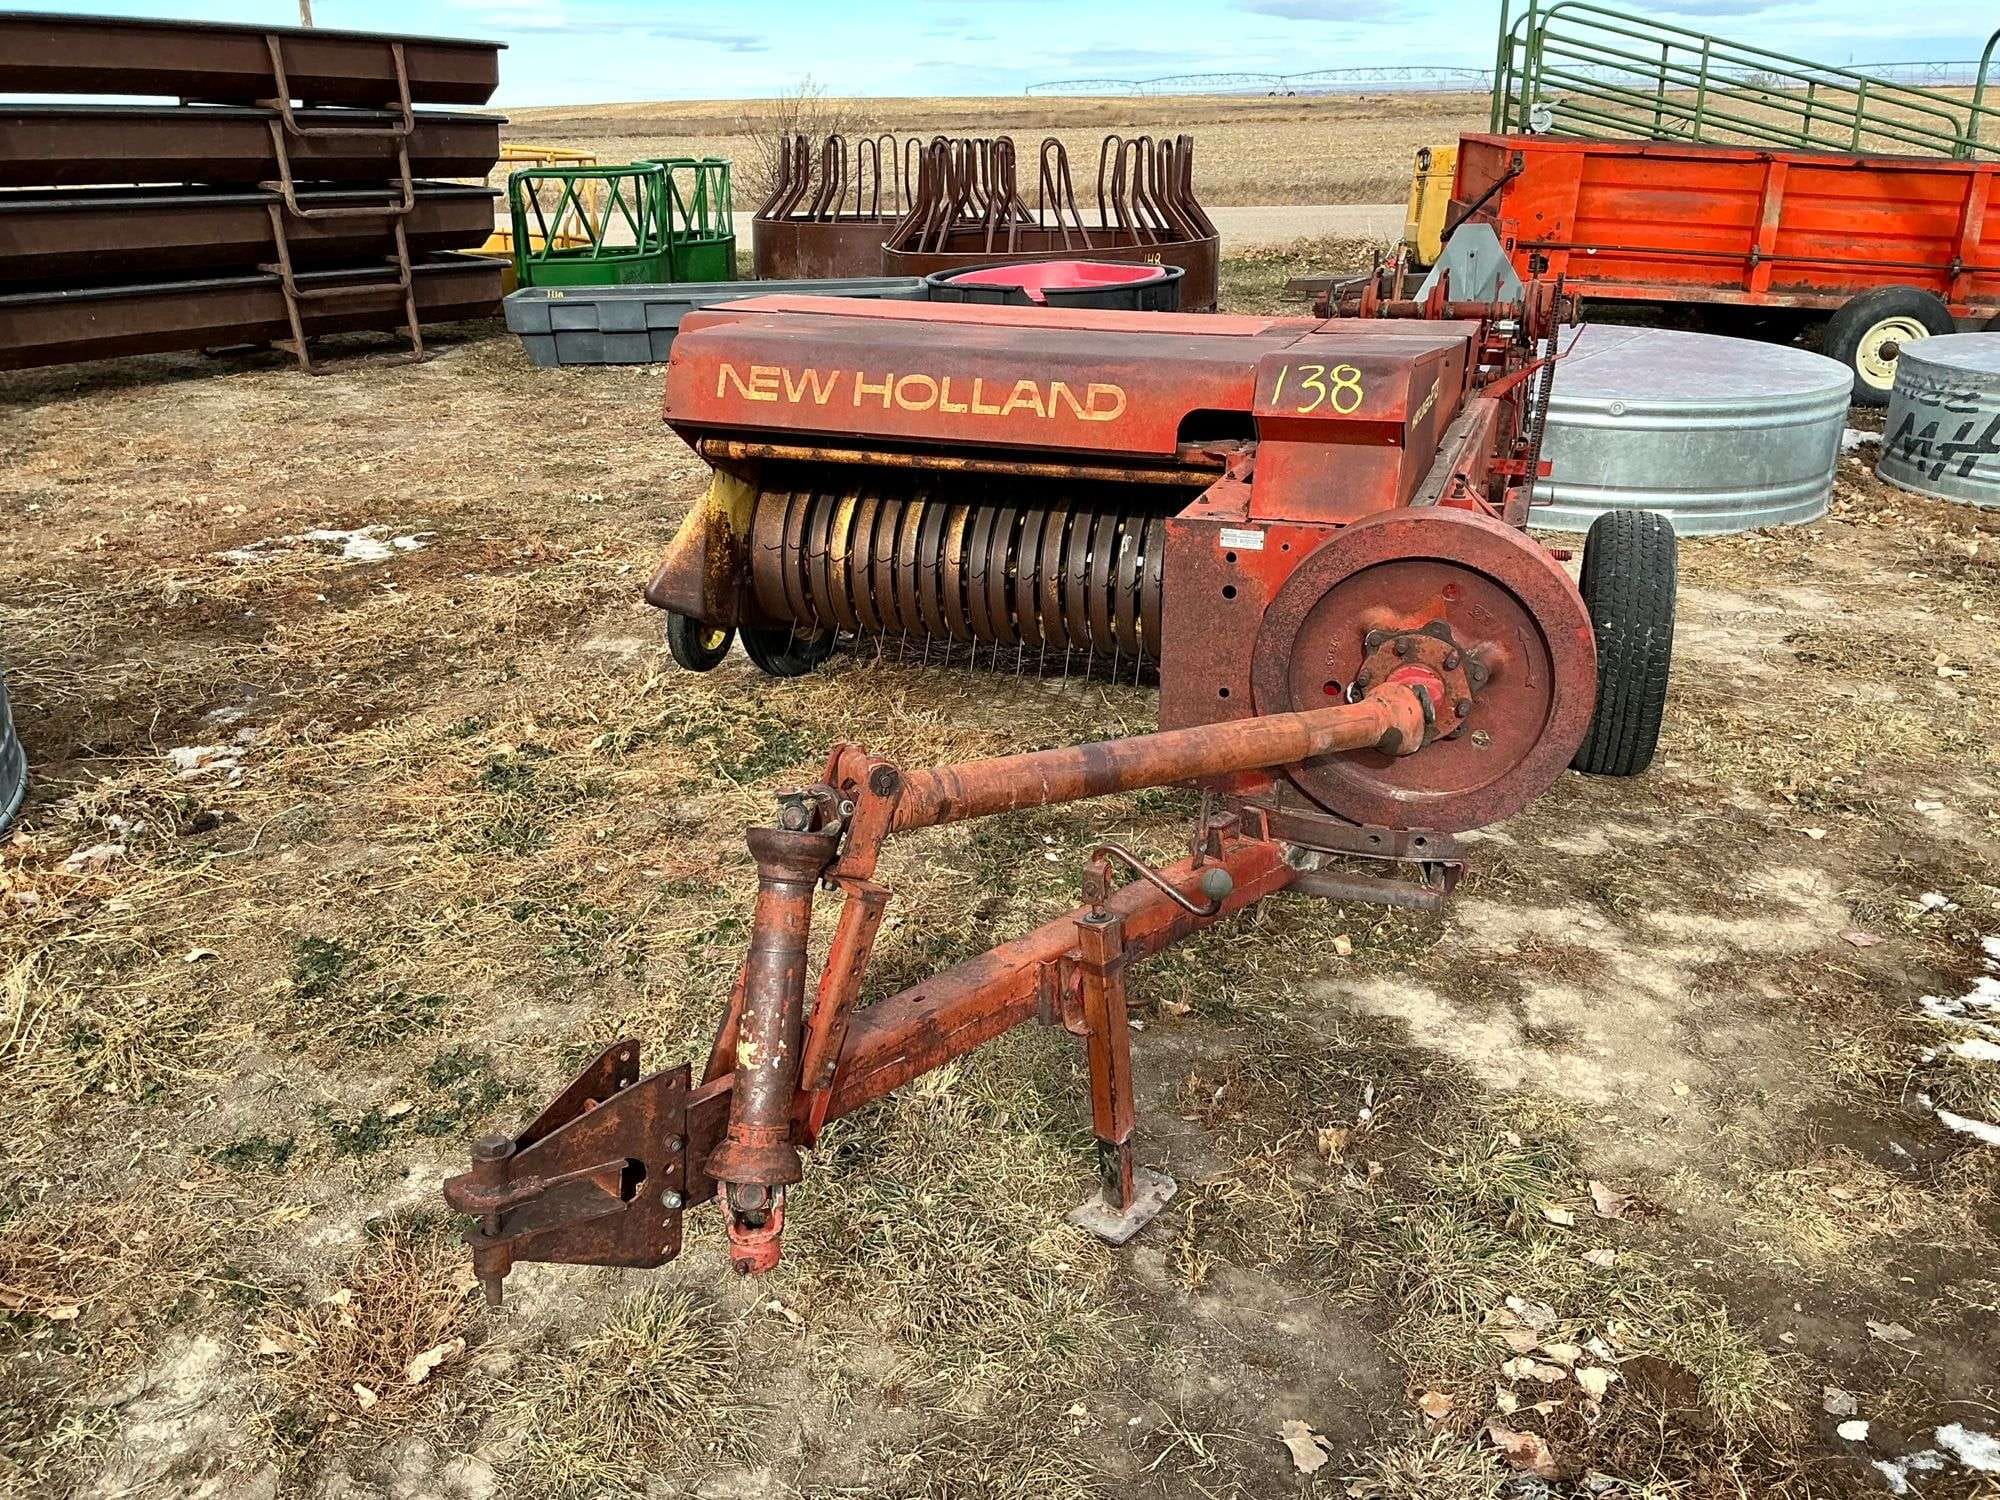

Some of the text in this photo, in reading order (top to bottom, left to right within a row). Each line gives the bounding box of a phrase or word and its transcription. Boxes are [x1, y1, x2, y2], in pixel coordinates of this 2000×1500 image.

[716, 363, 1128, 422] NEW HOLLAND
[1271, 363, 1365, 414] 138
